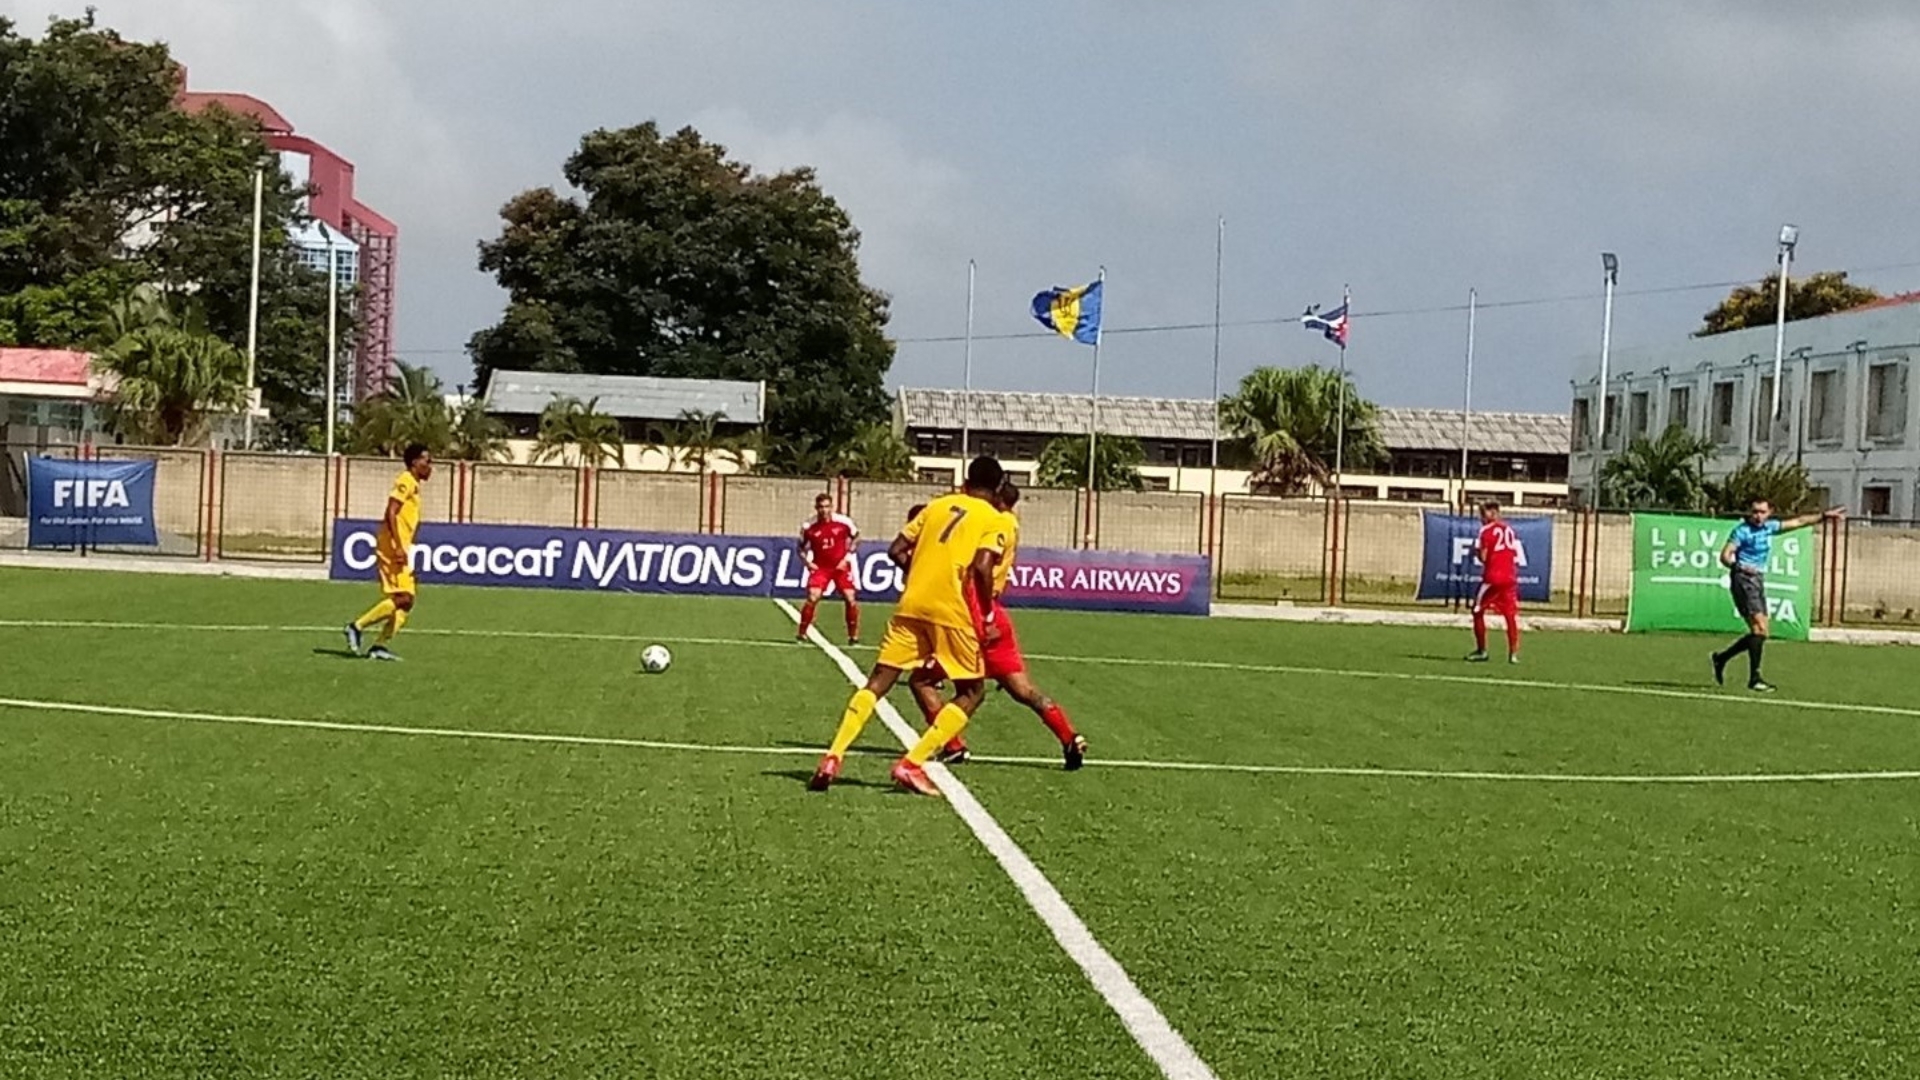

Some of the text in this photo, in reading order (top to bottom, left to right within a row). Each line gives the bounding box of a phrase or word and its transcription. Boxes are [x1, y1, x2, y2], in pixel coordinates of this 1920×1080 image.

[54, 480, 129, 507] FIFA
[938, 505, 967, 543] 7
[822, 538, 835, 550] 21
[1492, 526, 1516, 552] 20
[1652, 528, 1800, 556] LIVG
[343, 531, 563, 577] Cncacaf
[571, 540, 765, 587] NATIONS
[1652, 550, 1800, 577] FOOTLL
[1005, 566, 1181, 594] ATAR AIRWAYS
